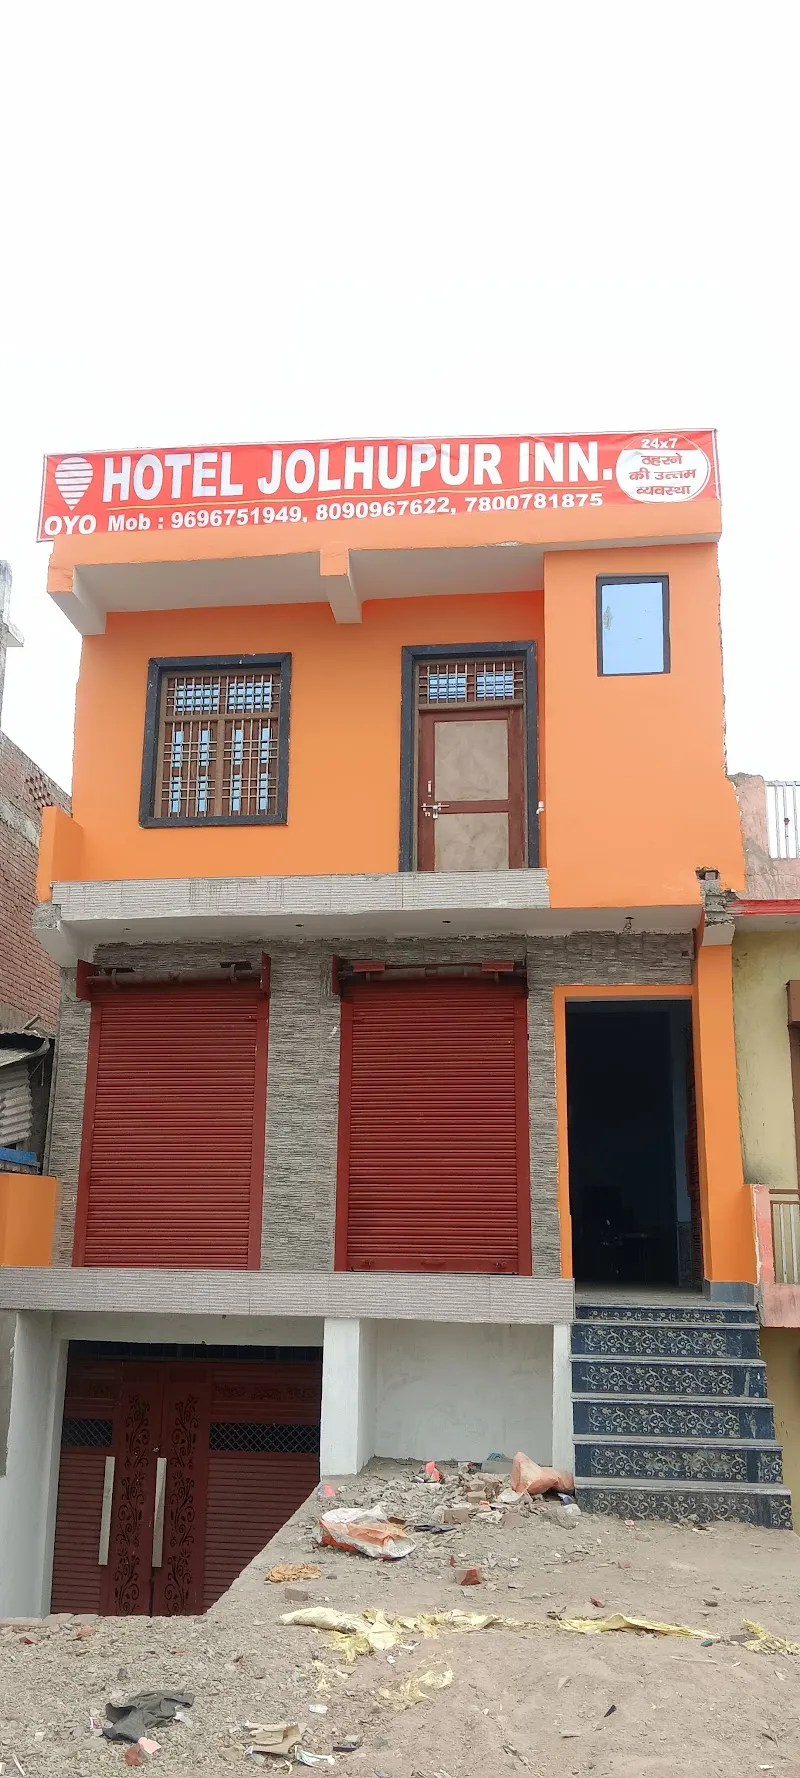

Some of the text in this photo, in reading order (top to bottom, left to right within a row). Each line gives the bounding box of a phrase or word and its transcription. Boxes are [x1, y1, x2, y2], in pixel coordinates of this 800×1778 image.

[641, 437, 678, 449] 24x7
[641, 452, 682, 466] ठहरने
[102, 441, 613, 502] HOTEL JOLHUPUR INN.
[629, 467, 696, 480] की उत्तम
[636, 485, 691, 496] व्यवस्था
[107, 514, 151, 532] Mob
[171, 505, 308, 529] 9696751949,
[315, 496, 457, 521] 8090967622,
[465, 492, 604, 512] 7800781875
[43, 514, 97, 536] OYO
